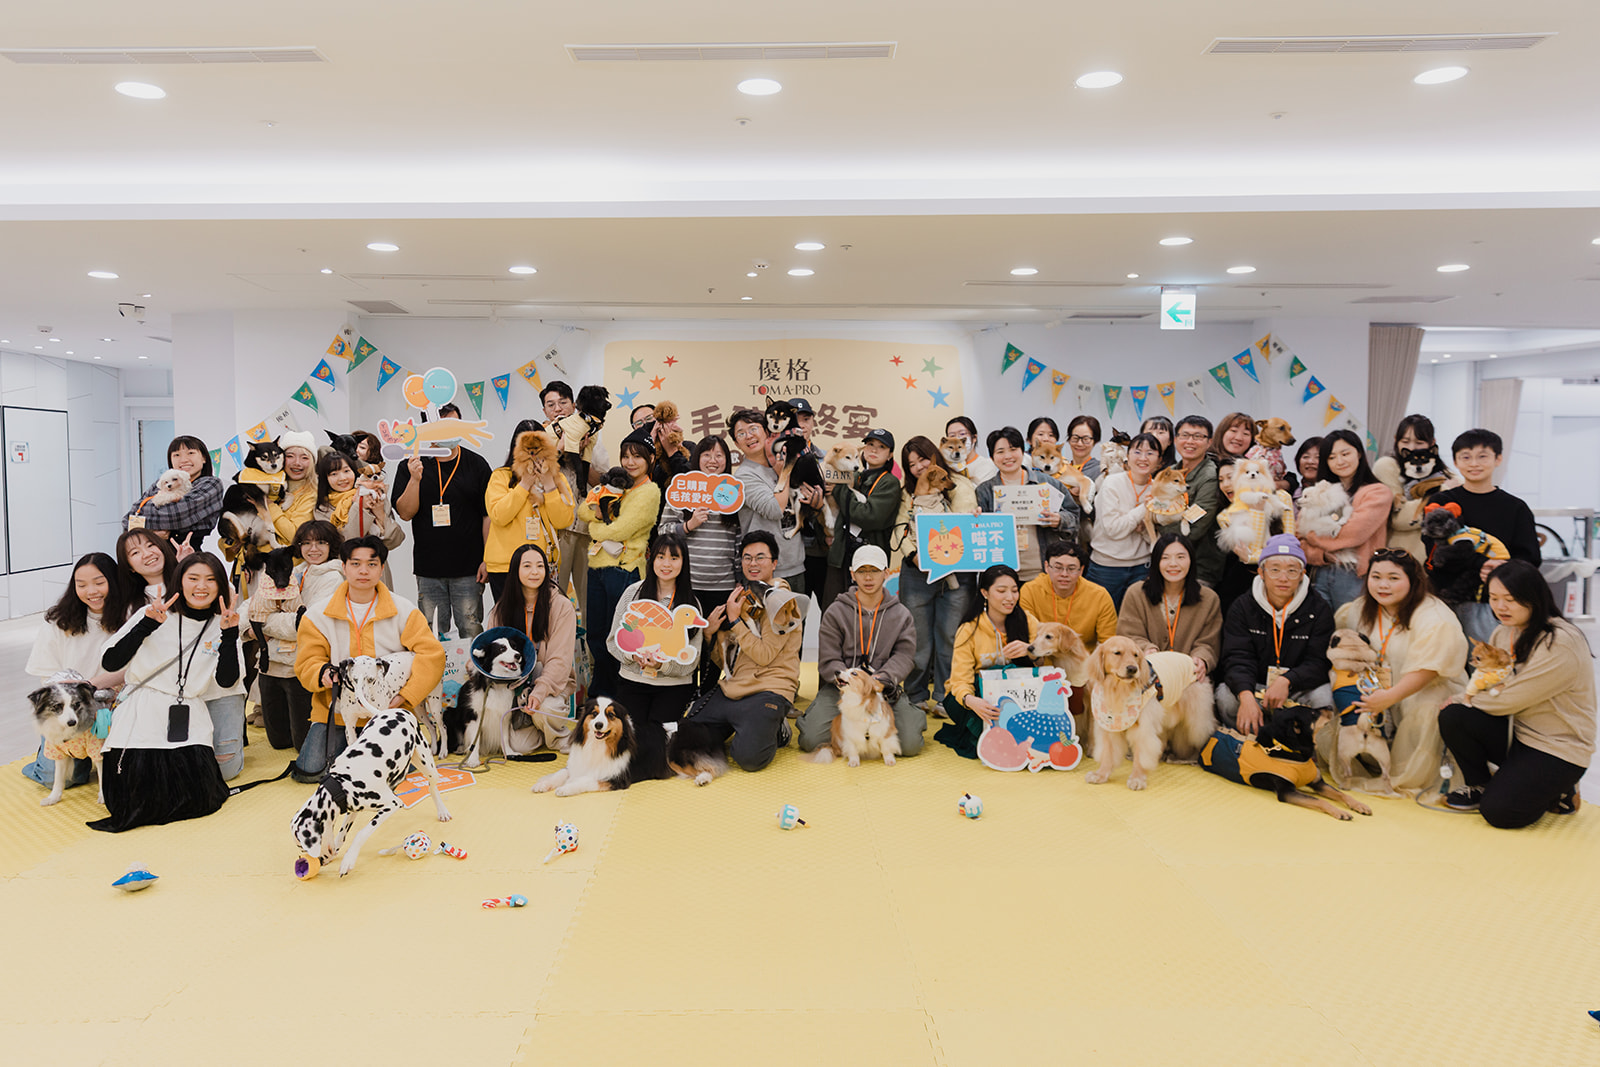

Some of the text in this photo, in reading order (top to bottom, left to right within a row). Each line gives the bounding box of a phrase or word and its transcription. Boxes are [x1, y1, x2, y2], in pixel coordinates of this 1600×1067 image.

[759, 358, 810, 381] 優格
[749, 384, 821, 395] TOMA-PRO
[676, 480, 708, 492] 已購買
[670, 491, 713, 505] 毛孩愛吃
[971, 530, 1004, 546] 喵不
[972, 547, 1005, 563] 可言
